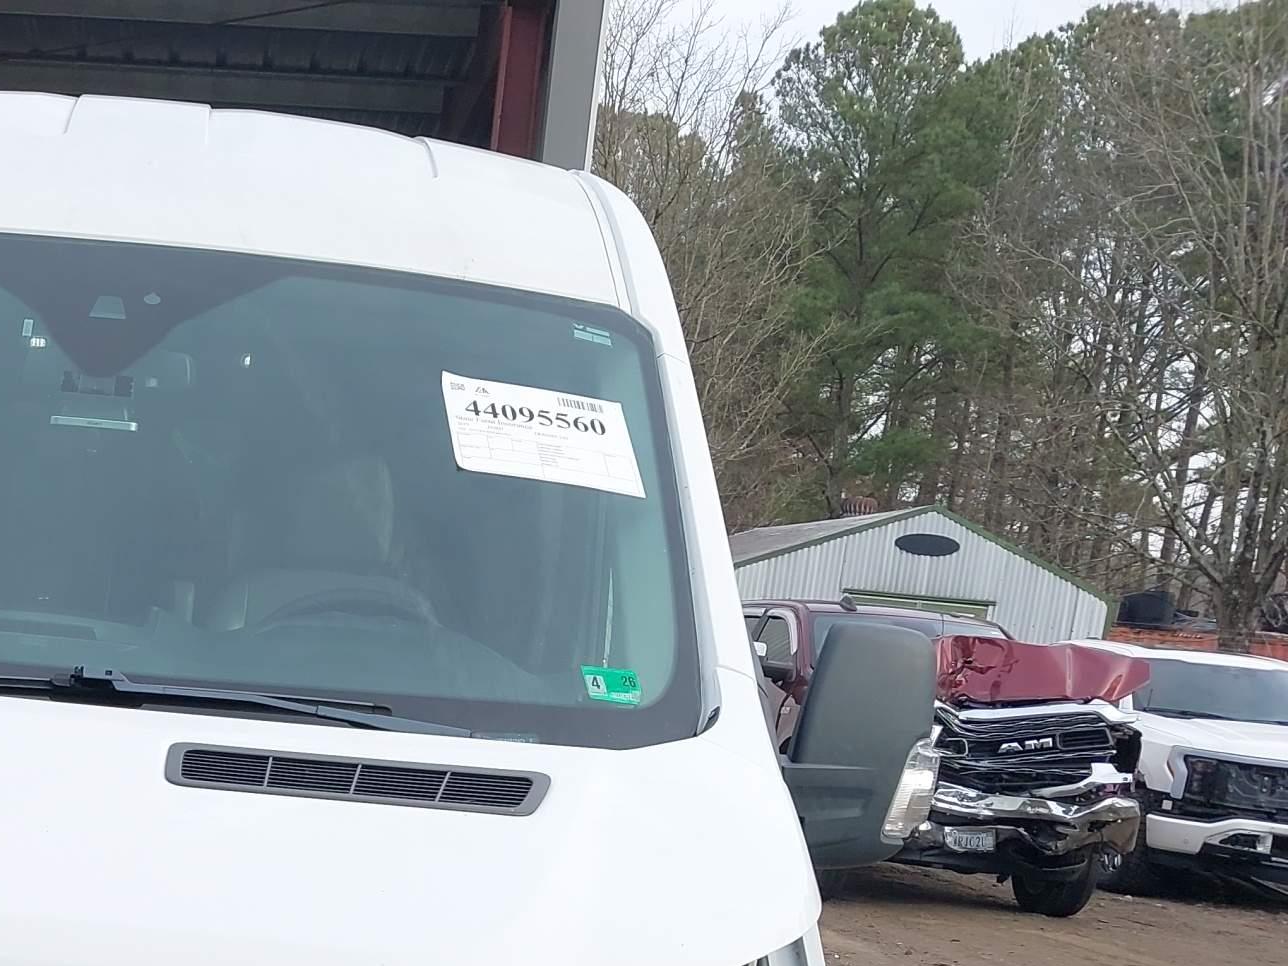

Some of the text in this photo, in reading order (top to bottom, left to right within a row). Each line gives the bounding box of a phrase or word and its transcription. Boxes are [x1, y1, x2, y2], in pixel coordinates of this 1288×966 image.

[465, 400, 606, 436] 44095560
[592, 675, 636, 690] 4 26
